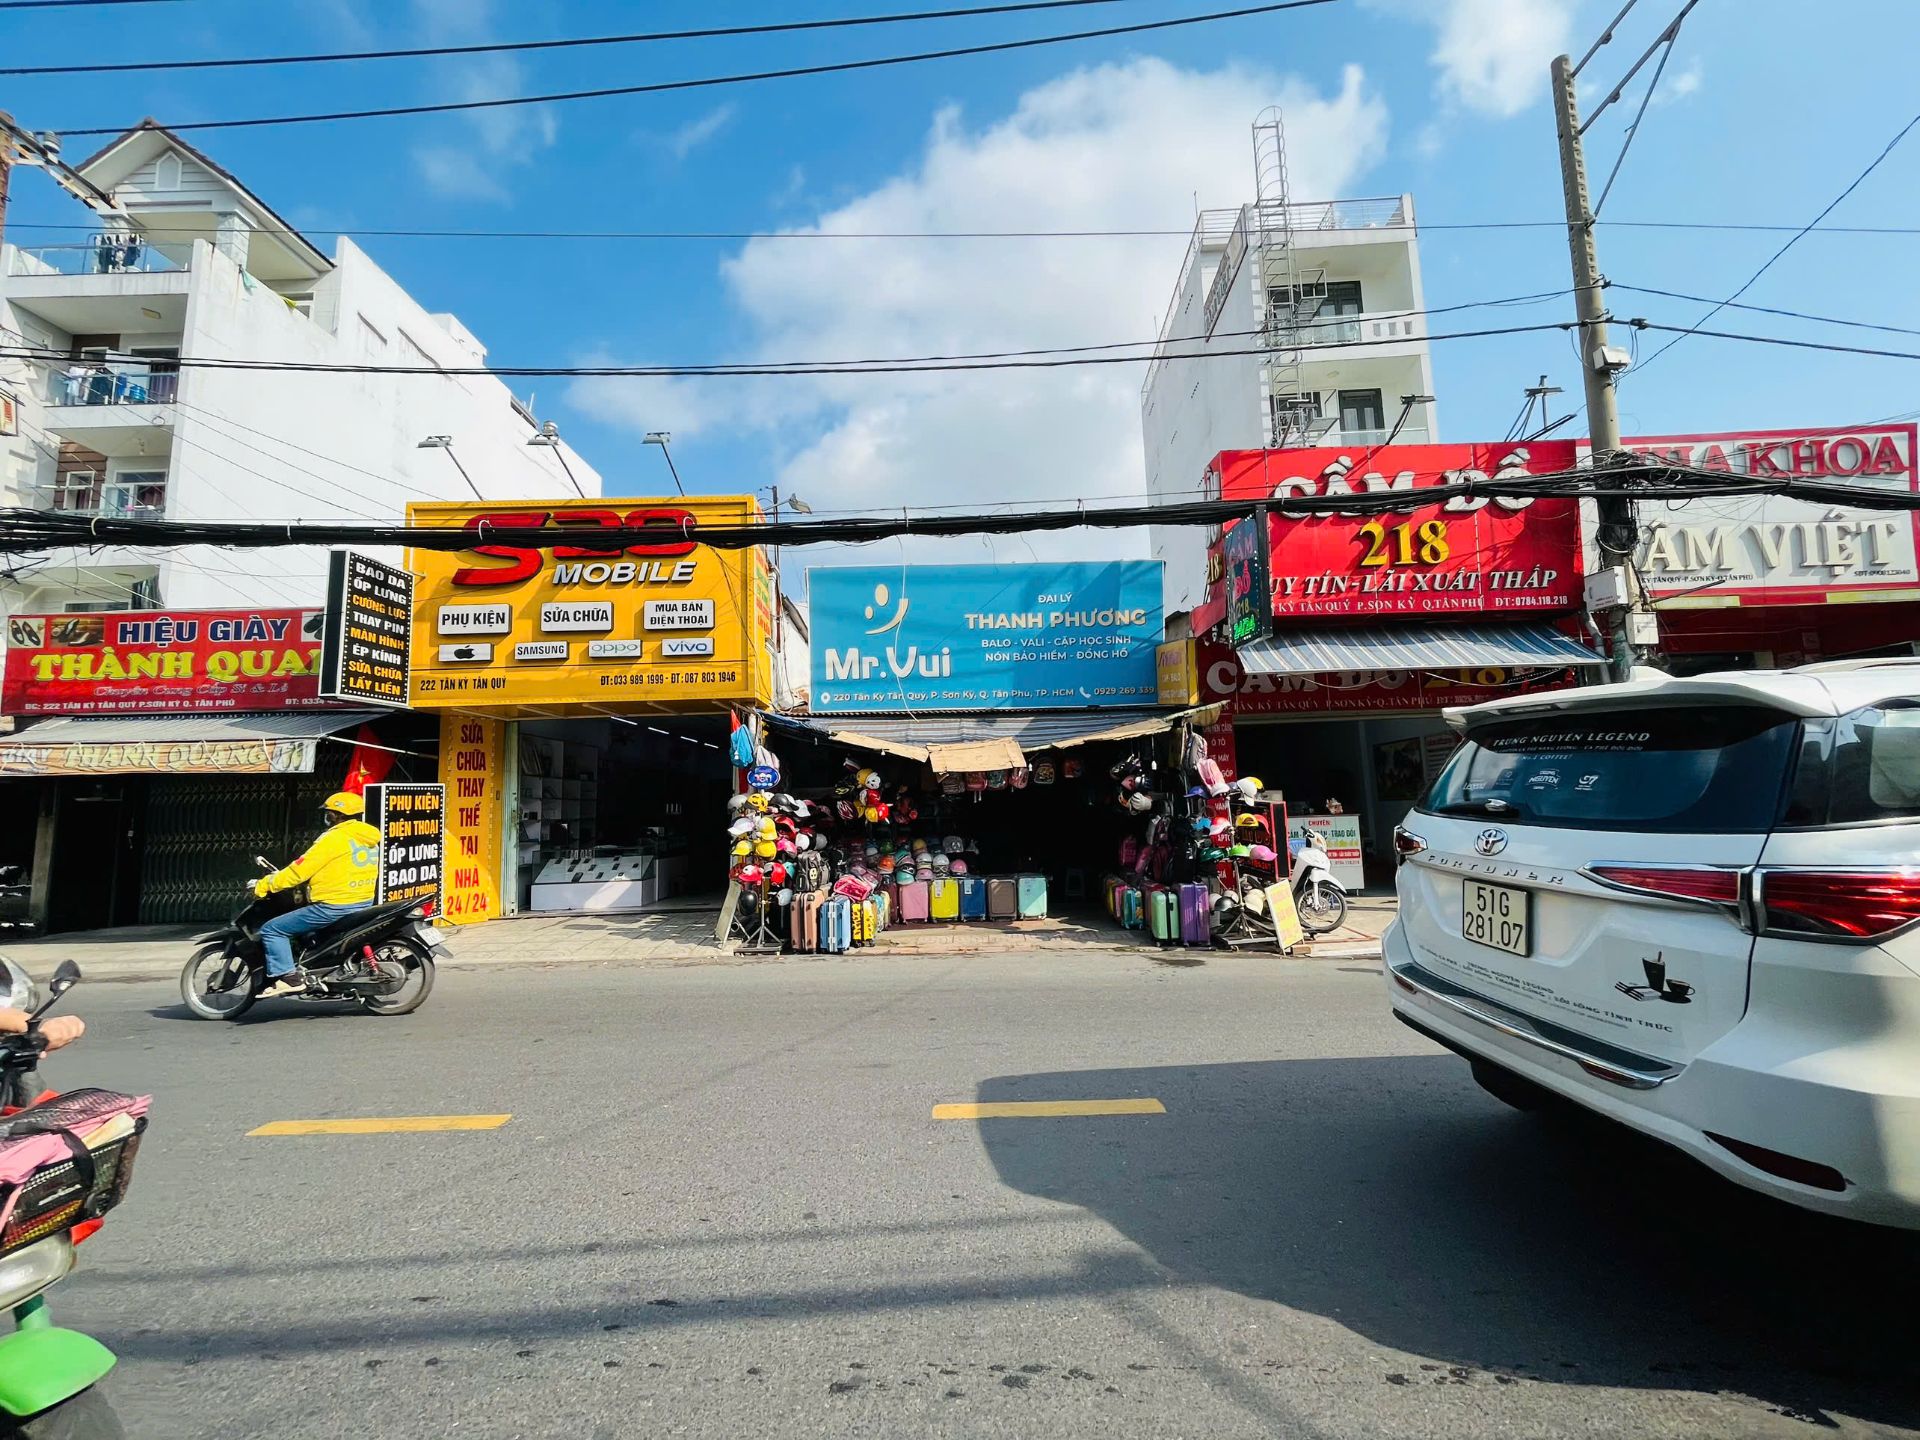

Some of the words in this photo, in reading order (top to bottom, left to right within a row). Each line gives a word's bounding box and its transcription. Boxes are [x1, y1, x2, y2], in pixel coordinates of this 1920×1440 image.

[1744, 436, 1909, 477] KHOA
[1360, 520, 1449, 566] 218
[1749, 508, 1897, 574] VIỆT
[355, 562, 385, 581] BAO
[388, 576, 406, 590] DA
[552, 561, 697, 584] MOBILE
[1413, 567, 1480, 591] XUẤT
[1490, 564, 1557, 589] THẤP
[353, 577, 371, 592] ỐP
[374, 585, 407, 606] LƯNG
[1038, 594, 1057, 605] ĐẠI
[1060, 592, 1073, 603] LÝ
[543, 607, 570, 623] SỬA
[573, 606, 609, 622] CHỮA
[656, 603, 678, 612] MUA
[681, 601, 703, 612] BÁN
[353, 611, 381, 627] THAY
[384, 620, 405, 635] PIN
[442, 613, 469, 628] PHỤ
[473, 610, 505, 627] KIỆN
[650, 616, 675, 627] ĐIỆN
[678, 615, 708, 626] THOẠI
[964, 612, 1044, 630] THANH
[1050, 608, 1147, 628] PHƯƠNG
[118, 616, 199, 648] HIỆU
[208, 615, 291, 642] GIÀY
[350, 627, 377, 643] MÀN
[379, 633, 405, 650] HÌNH
[981, 639, 1011, 648] BALO
[1020, 638, 1044, 647] VALI
[1079, 636, 1103, 646] HỌC
[1105, 635, 1131, 645] SINH
[353, 643, 369, 656] ÉP
[371, 649, 401, 665] KÍNH
[517, 645, 564, 656] SAMSUNG
[668, 641, 707, 652] vivo
[985, 650, 1010, 662] NÓN
[1013, 649, 1036, 661] BẢO
[31, 646, 195, 681] THÀNH
[349, 658, 371, 674] SỬA
[374, 665, 402, 680] CHỮA
[825, 646, 951, 680] Mr.Vui
[349, 675, 372, 691] LẤY
[420, 680, 436, 691] 222
[440, 677, 455, 690] TÂN
[473, 676, 487, 689] TÂN
[491, 676, 507, 689] QUÝ
[630, 674, 643, 684] 989
[647, 674, 664, 684] 1999
[701, 672, 715, 683] 803
[718, 671, 736, 682] 1946
[834, 694, 851, 702] 220
[1052, 688, 1074, 697] HCM
[1094, 687, 1117, 695] 0929
[461, 719, 484, 744] SỬA
[1493, 736, 1527, 747] TRUNG
[1587, 732, 1650, 742] LEGEND
[456, 749, 486, 771] CHỮA
[457, 777, 485, 797] THAY
[389, 795, 412, 814] PHỤ
[414, 791, 439, 813] KIỆN
[459, 802, 482, 827] THẾ
[389, 817, 412, 840] ĐIỆN
[413, 819, 439, 837] THOẠI
[389, 842, 406, 864] ỐP
[408, 843, 438, 862] LƯNG
[460, 835, 478, 858] TẠI
[388, 867, 417, 887] BAO
[420, 864, 437, 881] DA
[455, 864, 479, 889] NHÀ
[1428, 855, 1564, 885] FORTUNER
[1477, 886, 1510, 917] 51G
[1465, 911, 1524, 950] 281.07
